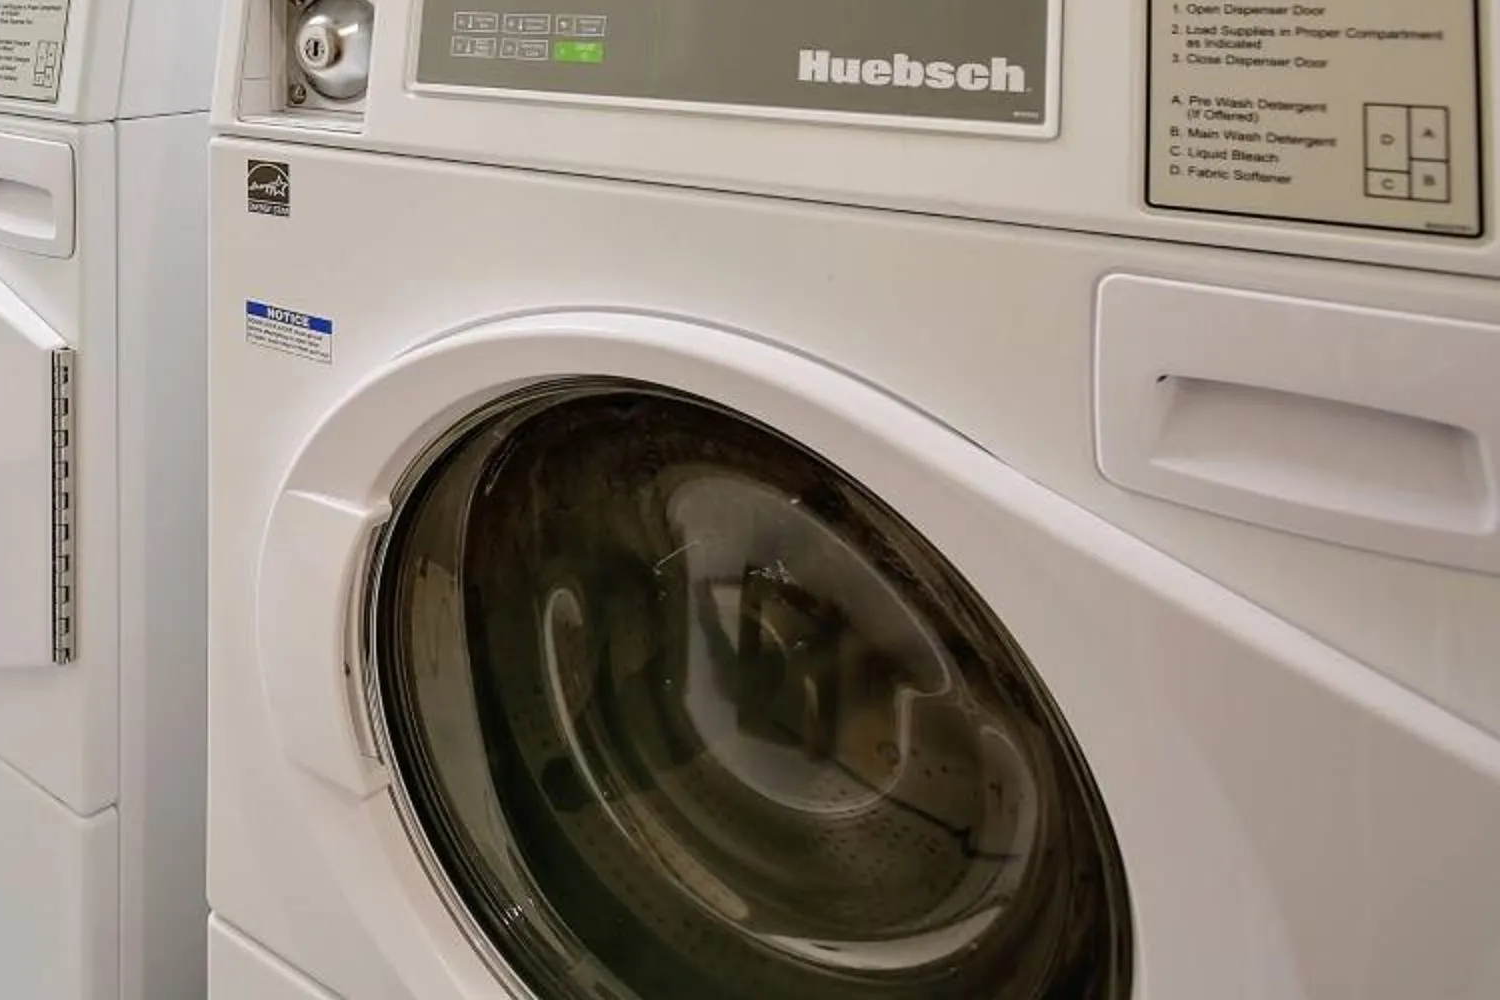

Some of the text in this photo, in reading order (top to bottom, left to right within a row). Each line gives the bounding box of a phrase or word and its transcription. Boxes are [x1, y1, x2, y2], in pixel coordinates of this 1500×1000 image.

[1186, 3, 1220, 15] Open
[1223, 3, 1288, 16] Dispenser
[1292, 5, 1326, 17] Door
[1186, 25, 1217, 36] Load
[1220, 25, 1275, 37] Supplies
[1280, 28, 1291, 37] in
[1295, 26, 1340, 39] Proper
[1345, 27, 1444, 41] Compartment
[1186, 39, 1262, 50] as Indicated
[1186, 53, 1221, 64] Close
[1225, 54, 1290, 67] Dispenser
[1295, 56, 1328, 68] Door
[798, 49, 1026, 93] Huebsch
[1188, 95, 1211, 107] Pre
[1215, 97, 1252, 109] Wash
[1257, 98, 1327, 113] Detergent
[1187, 127, 1220, 139] Main
[1224, 129, 1261, 142] Wash
[1266, 131, 1337, 148] Detergent
[1380, 133, 1396, 146] D
[1187, 147, 1228, 161] Liquid
[1231, 149, 1280, 163] Bleach
[1187, 165, 1230, 180] Fabric
[1233, 168, 1292, 184] Softener
[1380, 178, 1395, 191] C
[267, 307, 309, 327] NOTICE
